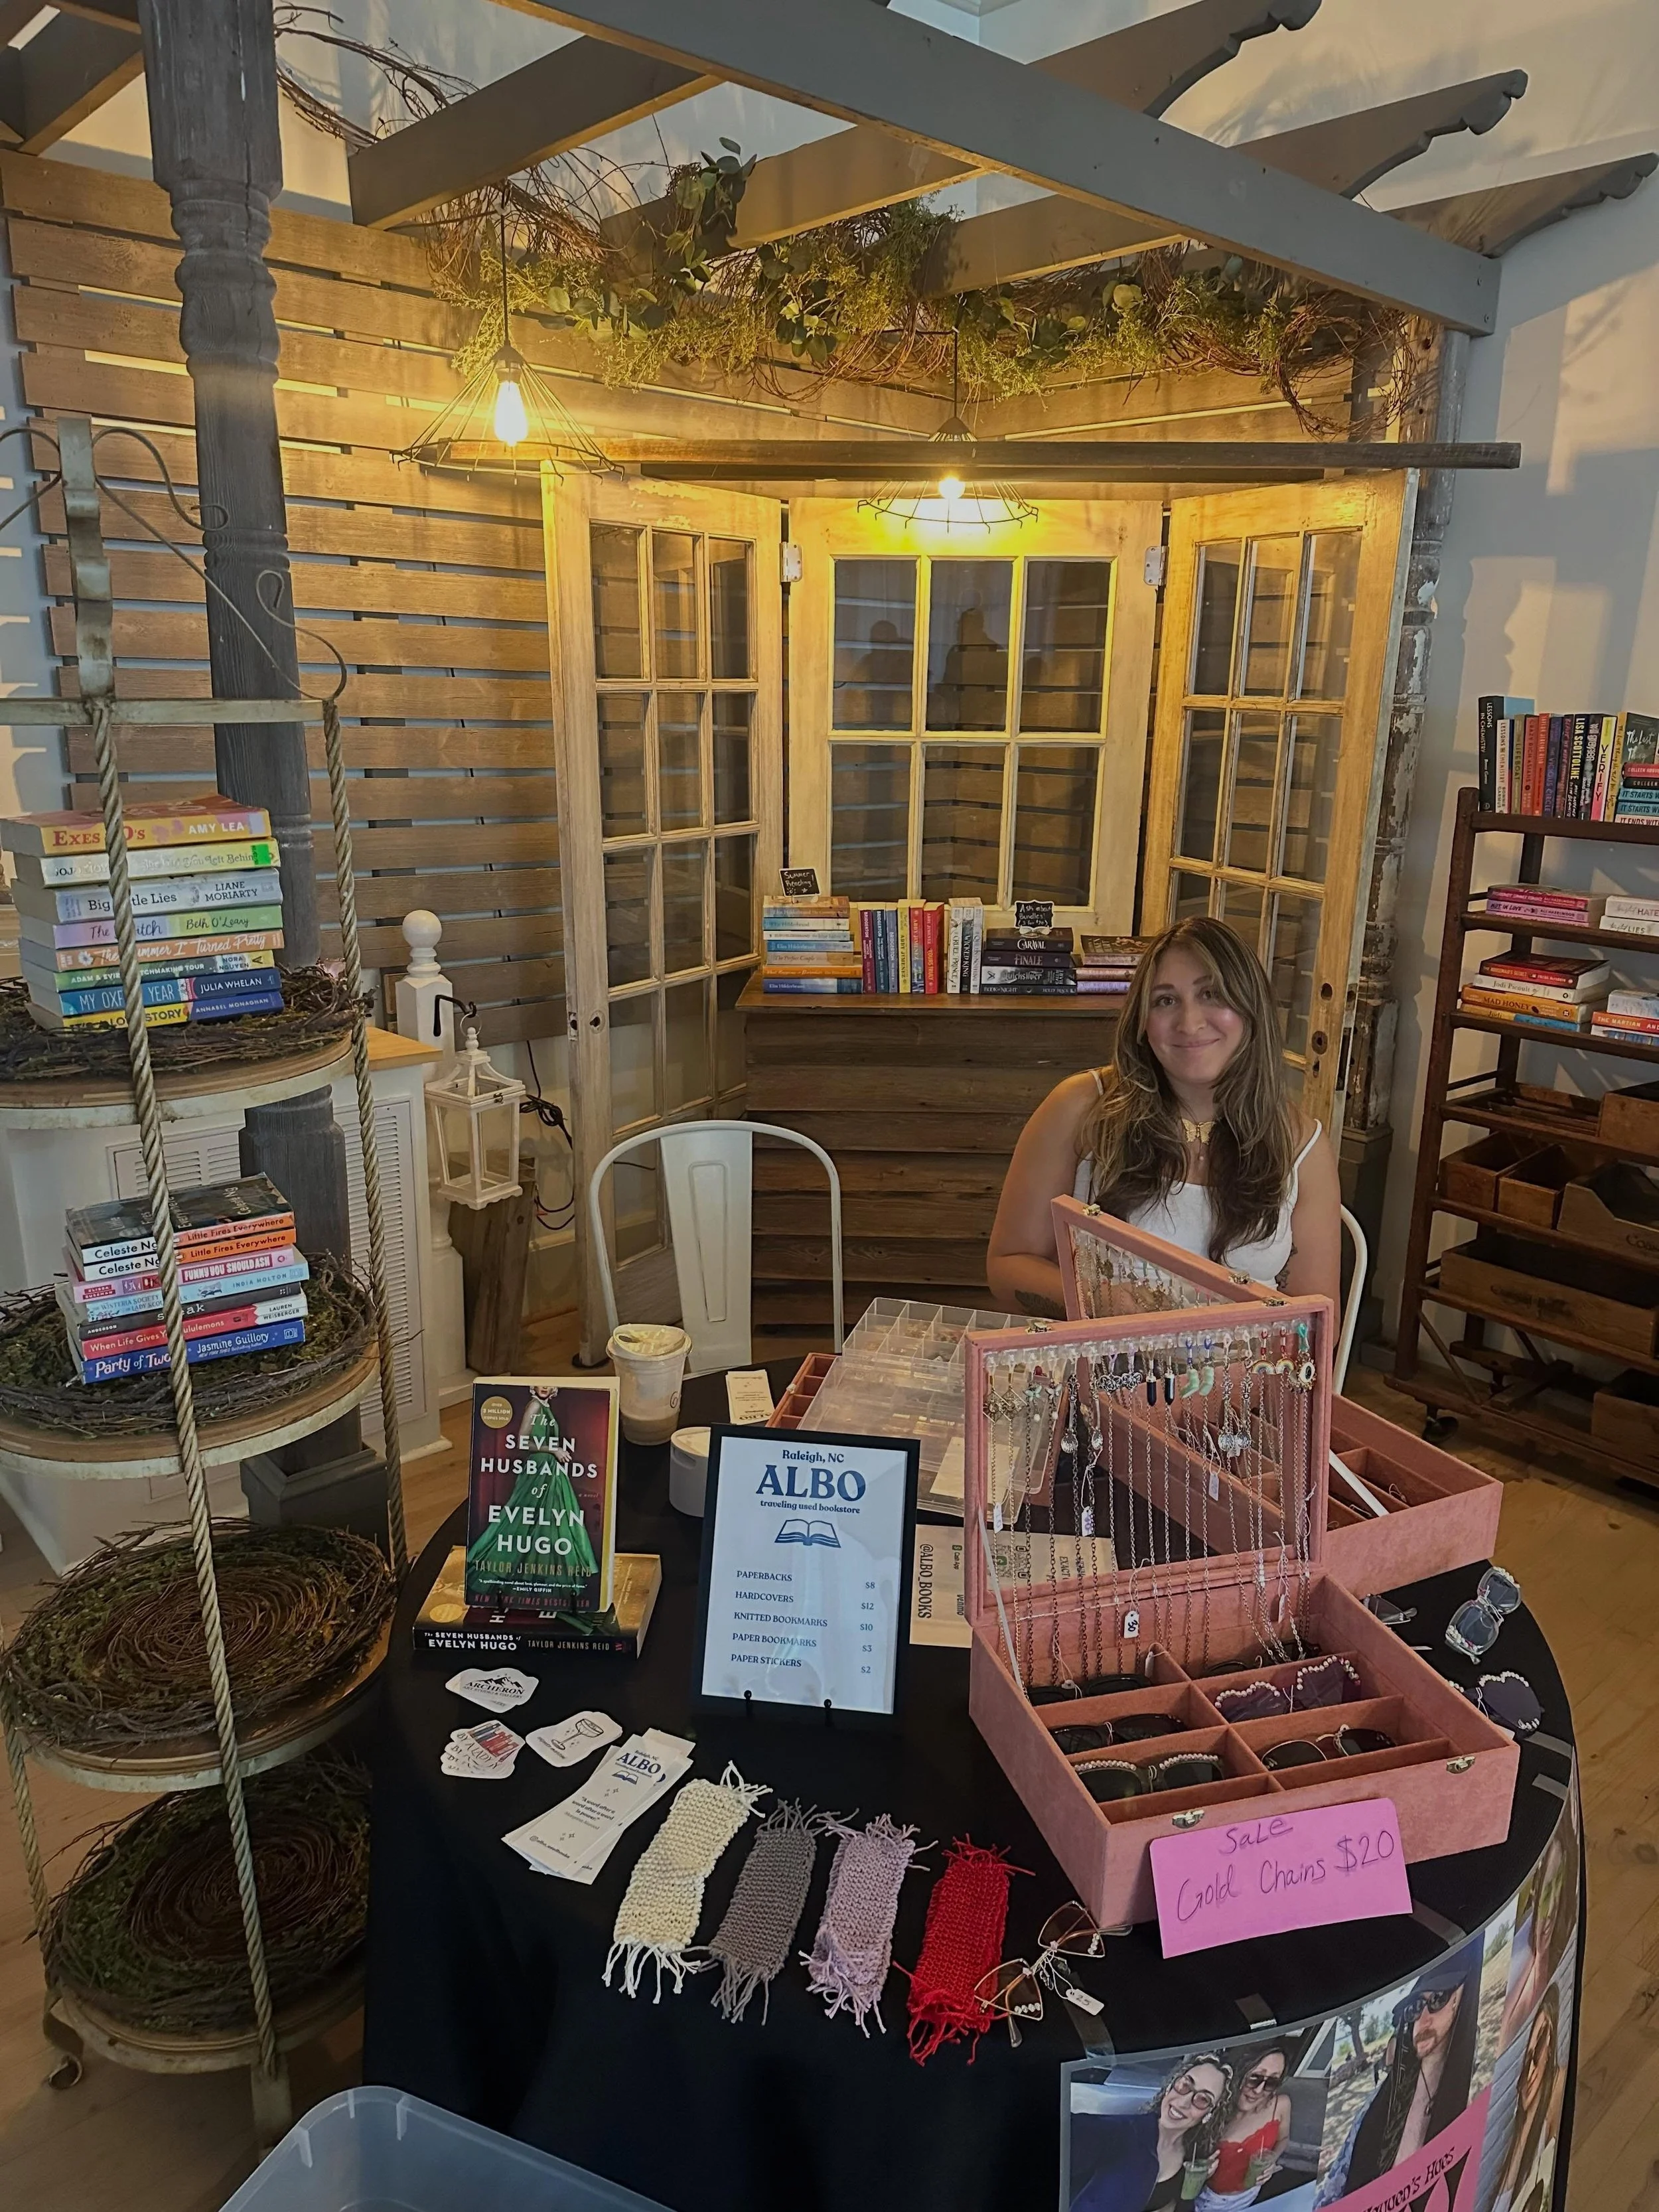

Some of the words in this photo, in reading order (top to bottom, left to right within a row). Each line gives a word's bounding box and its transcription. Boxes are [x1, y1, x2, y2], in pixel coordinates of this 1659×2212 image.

[1574, 718, 1585, 734] LISA
[1570, 735, 1583, 780] SCOTTOLINE
[1546, 759, 1555, 787] VICIOUS
[1545, 788, 1553, 812] CIRCLE
[188, 824, 216, 835] AMY
[221, 822, 245, 832] LEA
[784, 871, 810, 879] Summer
[215, 881, 246, 892] LIANE
[88, 899, 111, 912] Big
[151, 893, 177, 905] Lies
[205, 888, 258, 902] MORIARTY
[1637, 908, 1659, 917] HATE
[186, 919, 210, 930] Beth
[211, 917, 250, 928] O'Leary
[90, 925, 110, 940] The
[93, 948, 120, 966] The
[173, 941, 188, 957] I
[190, 938, 232, 954] Turned
[234, 934, 266, 950] Pretty
[1017, 938, 1046, 950] CARAVAL
[1014, 953, 1043, 966] FINALE
[71, 974, 94, 984] ADAM
[200, 982, 224, 994] JULIA
[224, 978, 263, 989] WHELAN
[1492, 980, 1506, 989] Jodi
[1507, 984, 1530, 993] Picoult
[80, 994, 96, 1011] MY
[148, 984, 175, 1002] YEAR
[195, 1004, 227, 1013] ANNABEL
[228, 997, 269, 1008] MONAGHAN
[1484, 996, 1501, 1006] MAD
[1502, 999, 1530, 1011] HONEY
[145, 1009, 182, 1023] STORY
[1611, 1018, 1641, 1027] MARTIAN
[94, 1245, 138, 1260] Celeste
[187, 1232, 208, 1242] Little
[210, 1228, 232, 1238] Fires
[233, 1218, 285, 1231] Everywhere
[99, 1262, 141, 1276] Celeste
[145, 1257, 160, 1268] Ng
[190, 1248, 212, 1258] Little
[214, 1245, 234, 1254] Fires
[236, 1236, 287, 1250] Everywhere
[209, 1265, 225, 1276] YOU
[226, 1260, 255, 1274] SHOULD
[232, 1280, 253, 1289] INDIA
[256, 1273, 287, 1284] HOLTON
[133, 1294, 159, 1305] SOCIETY
[269, 1303, 293, 1312] LAUREN
[263, 1308, 300, 1320] WEISBERGER
[90, 1343, 116, 1353] When
[117, 1338, 133, 1347] Life
[136, 1334, 159, 1343] Gives
[197, 1339, 233, 1354] Jasmine
[235, 1332, 269, 1346] Guillory
[95, 1357, 131, 1378] Party
[133, 1355, 145, 1369] of
[145, 1353, 171, 1368] Two
[530, 1414, 556, 1427] The
[505, 1434, 575, 1453] SEVEN
[782, 1449, 826, 1464] Raleigh,
[828, 1453, 845, 1463] NC
[480, 1457, 598, 1479] HUSBANDS
[532, 1483, 548, 1499] of
[755, 1464, 867, 1502] ALBO
[760, 1500, 798, 1511] traveling
[798, 1501, 818, 1511] used
[818, 1503, 861, 1514] bookstore
[488, 1505, 585, 1527] EVELYN
[497, 1534, 573, 1556] HUGO
[474, 1560, 512, 1574] TAYLOR
[517, 1562, 563, 1577] JENKINS
[567, 1564, 593, 1578] REID
[736, 1570, 793, 1582] PAPERBACKS
[865, 1582, 876, 1590] $8
[917, 1544, 934, 1619] @ALBO_BOOKS
[474, 1594, 491, 1603] NEW
[518, 1597, 541, 1605] TIMES
[735, 1591, 794, 1603] HARDCOVERS
[861, 1602, 875, 1611] $12
[733, 1611, 772, 1623] KNITTED
[772, 1615, 828, 1627] BOOKMARKS
[860, 1623, 874, 1632] $10
[428, 1639, 476, 1649] EVELYN
[480, 1641, 518, 1651] HUGO
[467, 1633, 514, 1641] HUSBANDS
[528, 1639, 554, 1649] TAYLOR
[557, 1641, 589, 1651] JENKINS
[592, 1642, 610, 1651] REID
[732, 1633, 760, 1643] PAPER
[761, 1635, 817, 1648] BOOKMARKS
[862, 1644, 873, 1653] $3
[731, 1653, 759, 1664] PAPER
[760, 1655, 802, 1668] STICKERS
[861, 1666, 871, 1674] $2
[465, 1682, 526, 1696] ARCHERON
[457, 1732, 469, 1741] BY
[471, 1746, 493, 1763] LADY
[616, 1752, 662, 1775] ALBO
[1177, 1864, 1238, 1923] Gold
[1260, 1859, 1327, 1895] Chains
[1334, 1829, 1394, 1876] $20
